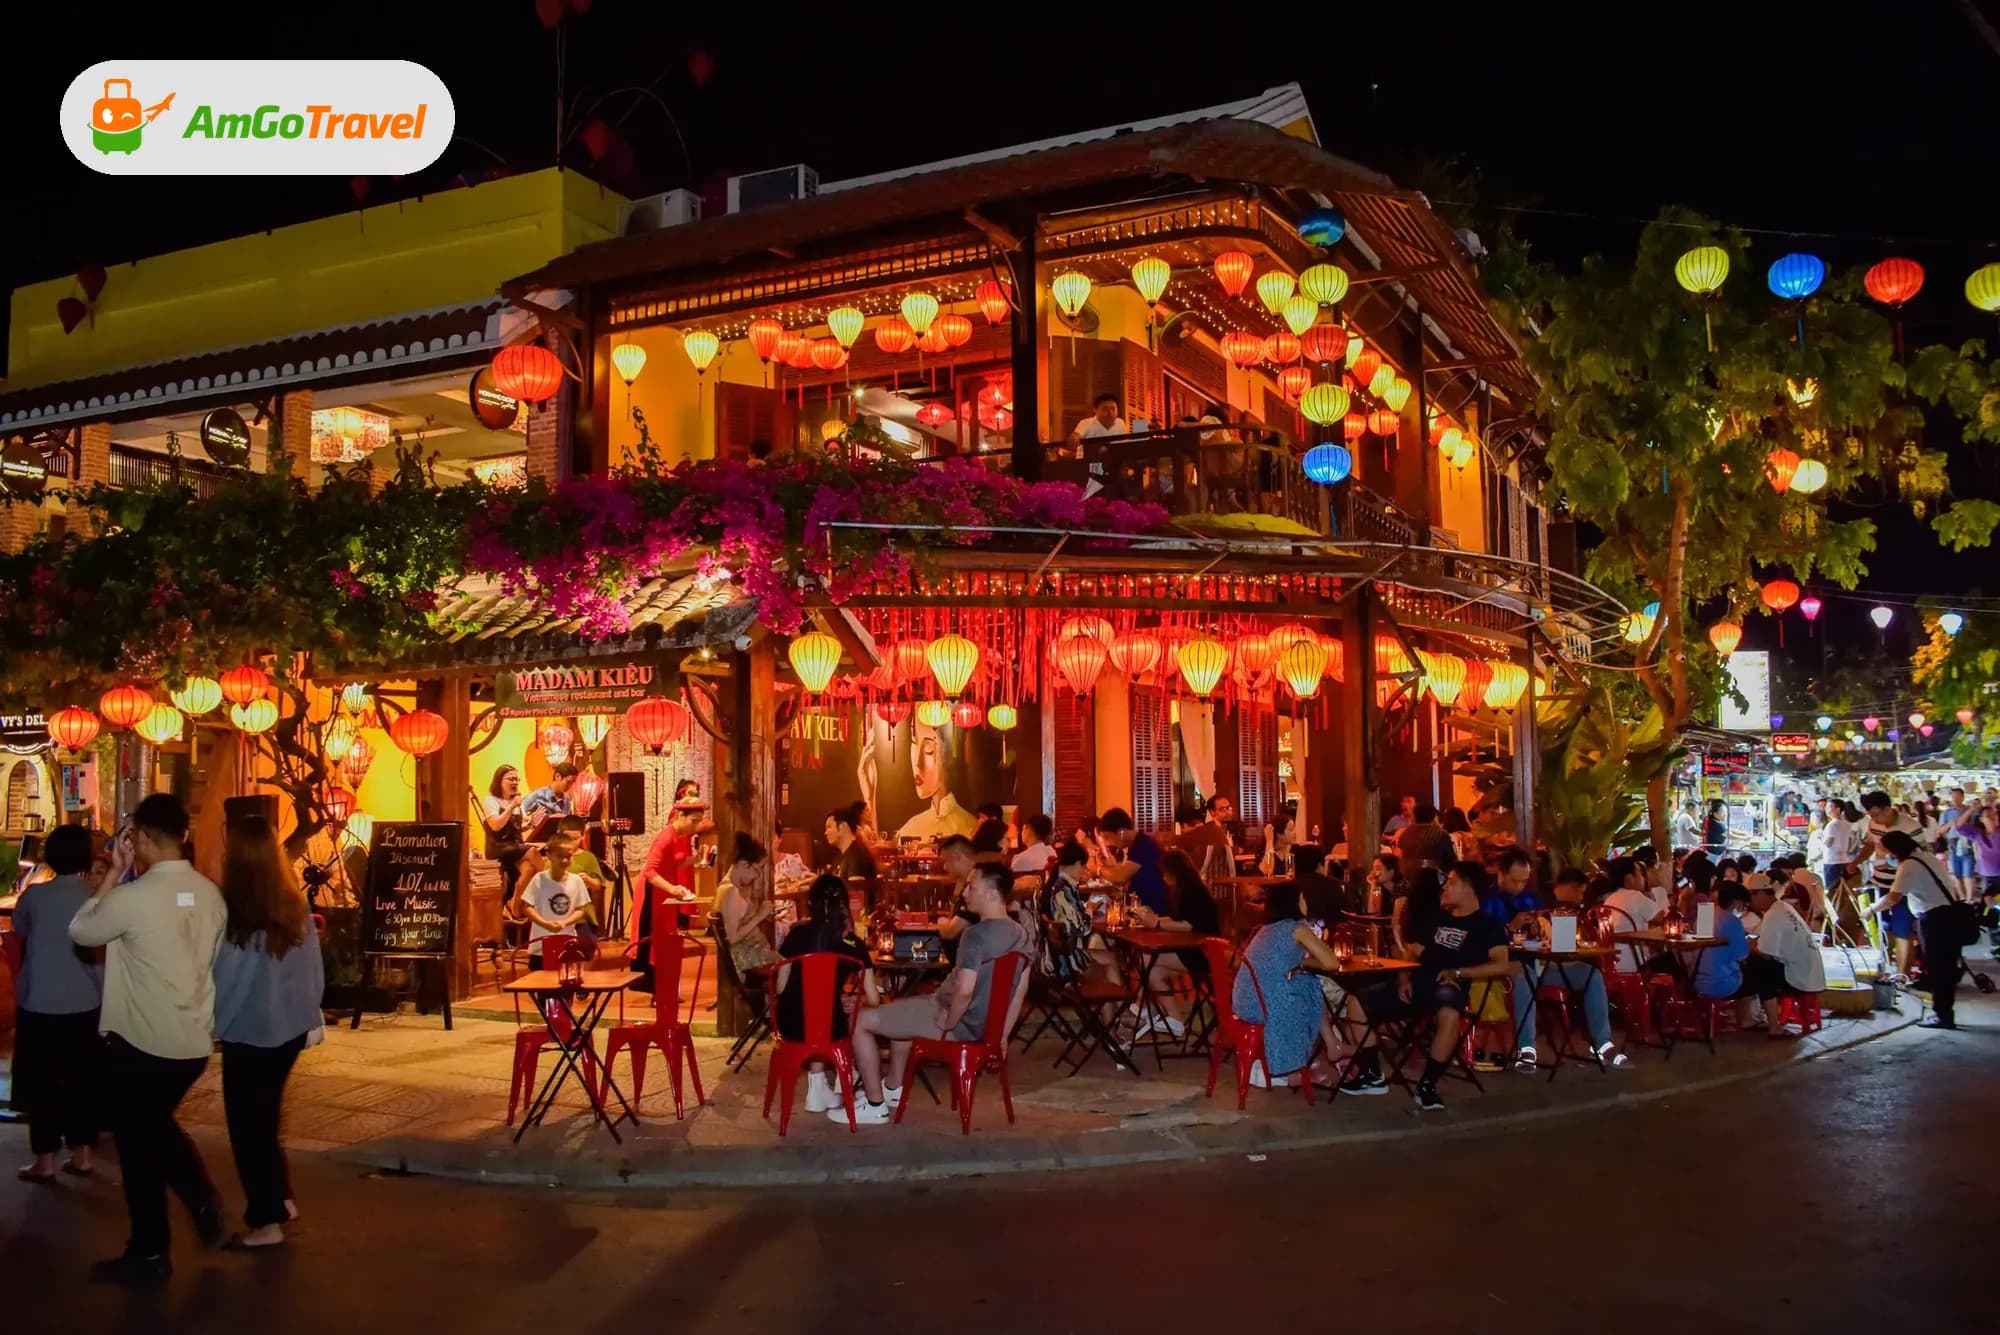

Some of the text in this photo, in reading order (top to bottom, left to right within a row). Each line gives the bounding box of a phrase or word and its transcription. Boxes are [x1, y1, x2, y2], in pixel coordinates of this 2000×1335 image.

[516, 669, 595, 691] MADAM
[571, 689, 612, 701] restaurant
[613, 688, 630, 698] and
[631, 688, 646, 698] bar
[25, 714, 48, 726] DEL
[380, 827, 448, 849] Promotion
[389, 851, 438, 866] Discount
[393, 871, 424, 892] 10%
[375, 894, 438, 911] Live Music
